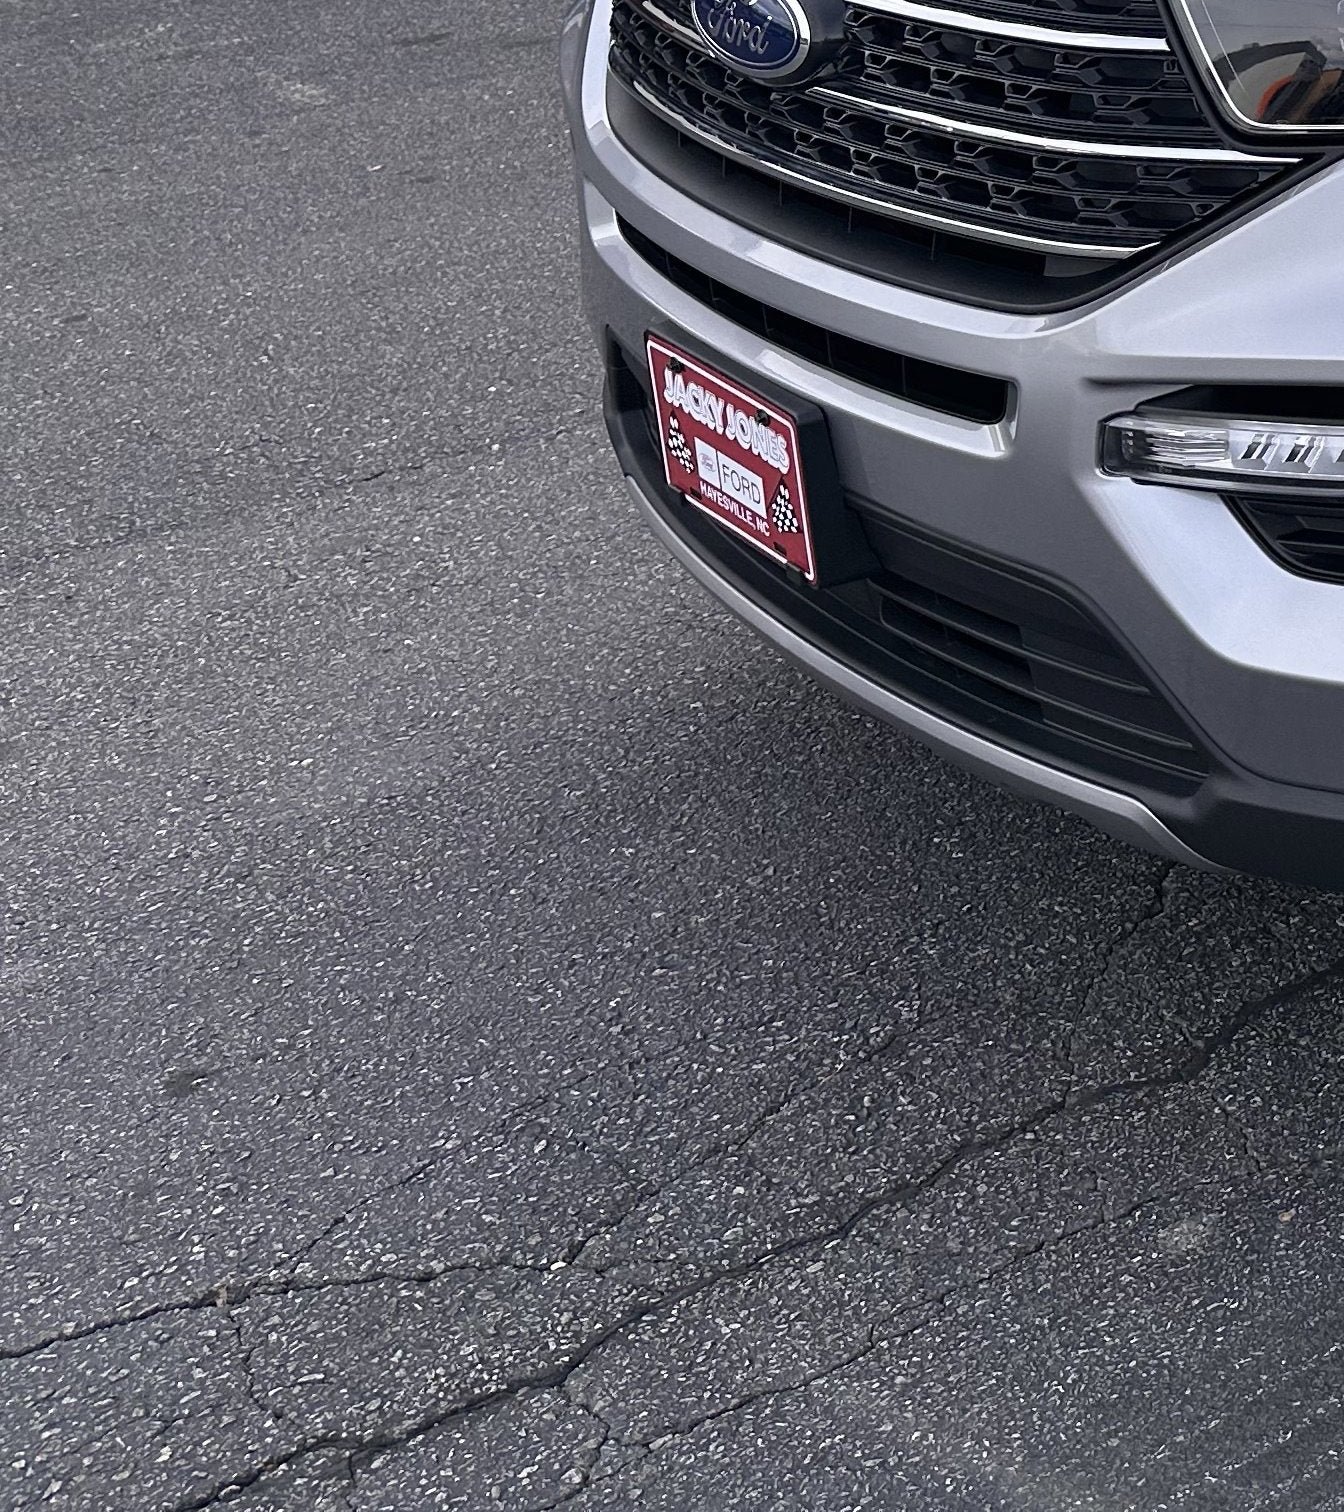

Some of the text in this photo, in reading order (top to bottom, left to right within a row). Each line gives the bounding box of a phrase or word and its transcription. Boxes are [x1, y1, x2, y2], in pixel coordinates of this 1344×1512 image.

[664, 366, 790, 475] JACKY JONES
[700, 480, 756, 531] HAYESVILLE,
[722, 463, 761, 505] FORD
